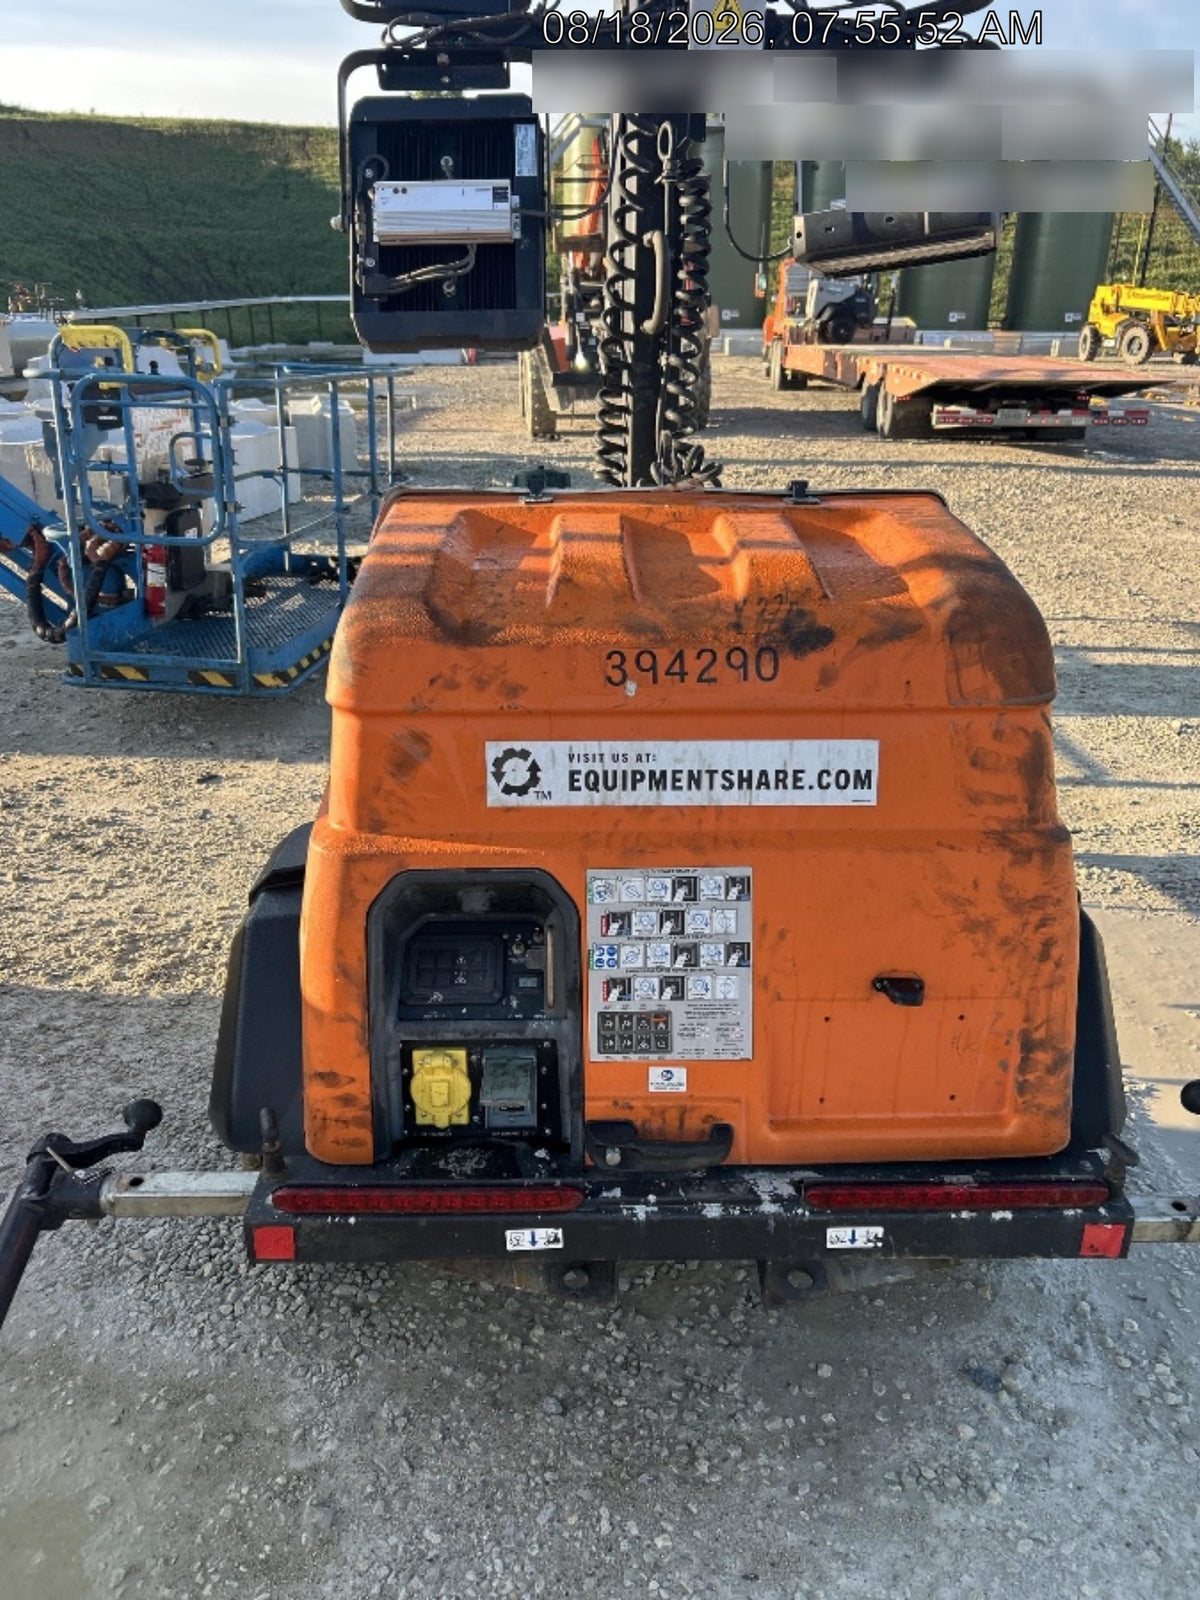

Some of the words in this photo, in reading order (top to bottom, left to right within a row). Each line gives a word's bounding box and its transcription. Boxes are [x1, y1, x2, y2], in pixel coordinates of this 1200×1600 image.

[605, 646, 780, 686] 394290
[568, 752, 605, 763] VISIT
[611, 752, 629, 763] US
[636, 752, 657, 763] AT:
[568, 769, 872, 793] EQUIPMENTSHARE.COM
[533, 790, 552, 801] TM
